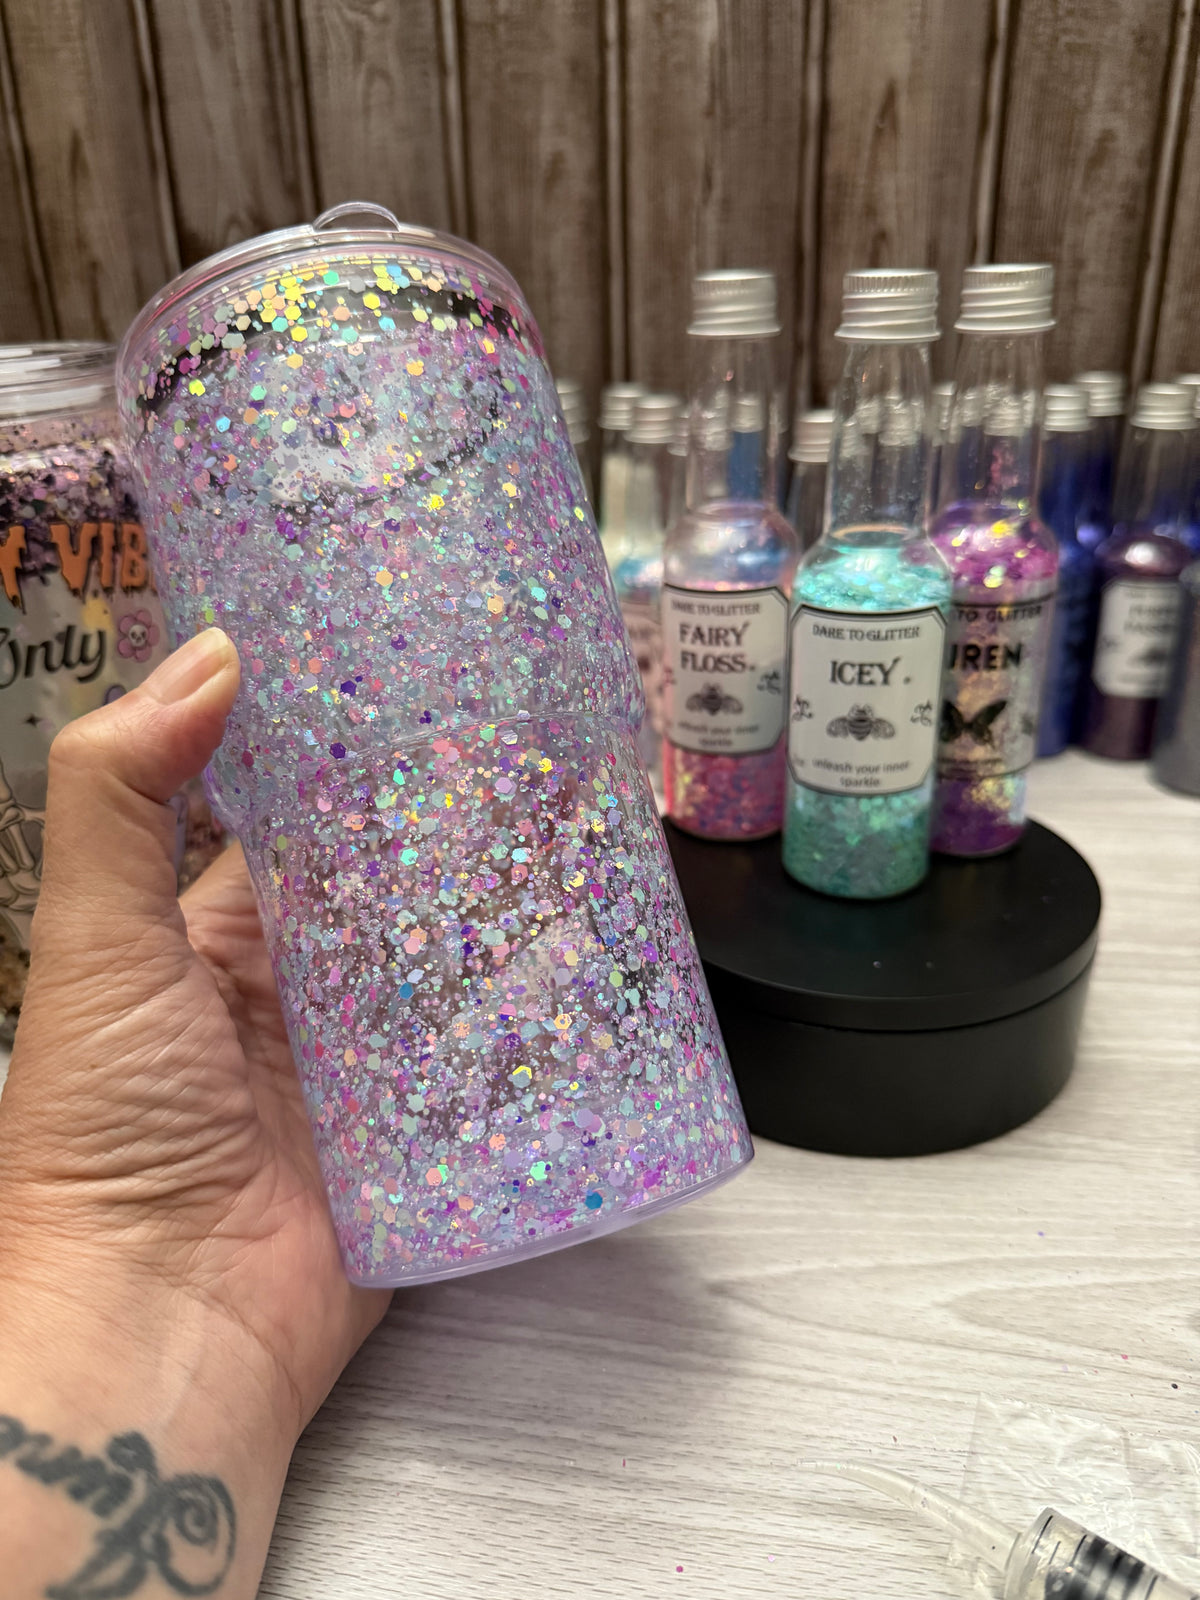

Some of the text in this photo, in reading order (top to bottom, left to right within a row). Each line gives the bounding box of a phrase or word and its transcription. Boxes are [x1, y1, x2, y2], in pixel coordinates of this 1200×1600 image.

[50, 521, 158, 602] VIB
[680, 621, 749, 647] FAIRY
[812, 623, 920, 642] DARE TO GLITTER
[855, 763, 881, 776] your
